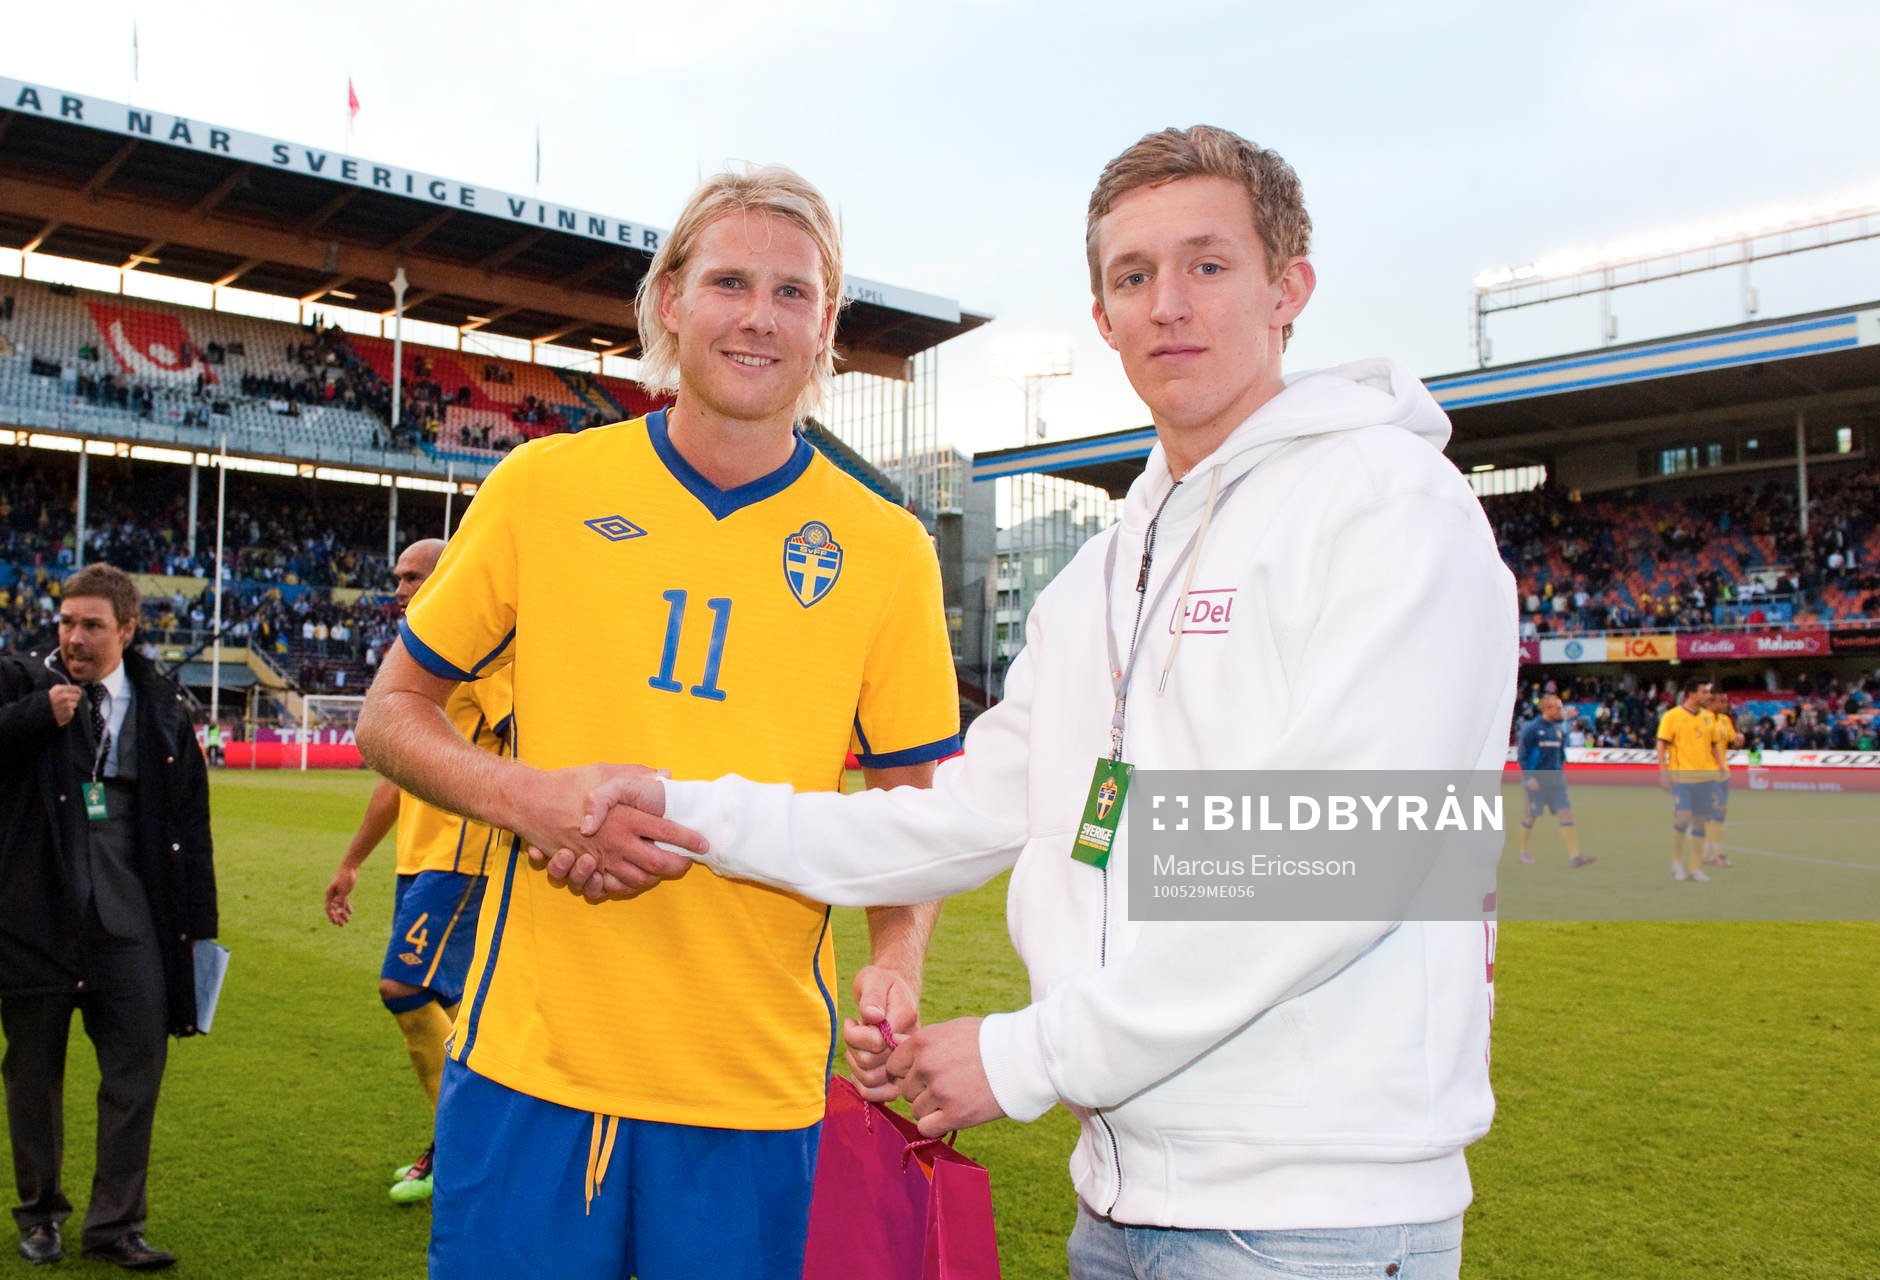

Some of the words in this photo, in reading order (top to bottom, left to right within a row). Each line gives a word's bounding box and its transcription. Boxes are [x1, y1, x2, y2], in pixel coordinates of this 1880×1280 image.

[127, 109, 231, 152] NÄR
[272, 144, 476, 208] SVERIGE
[507, 198, 659, 249] VINNER
[648, 588, 733, 702] 11
[405, 912, 429, 954] 4
